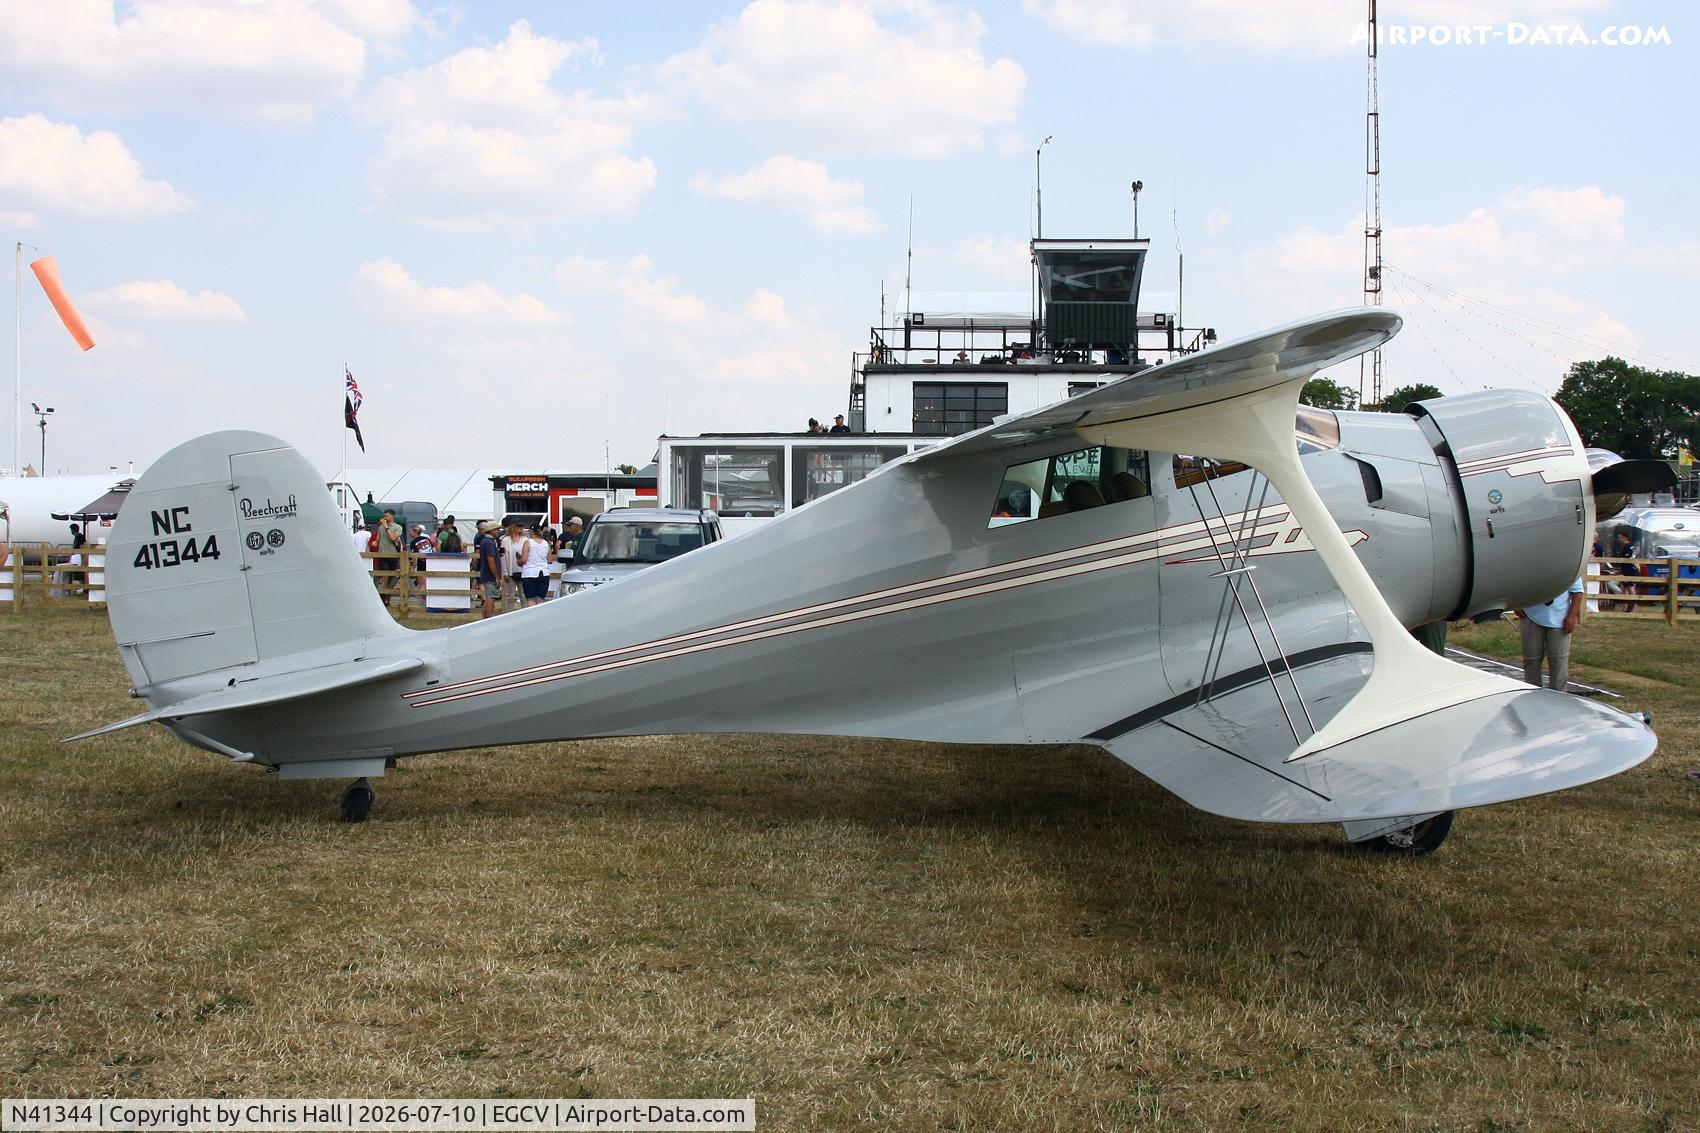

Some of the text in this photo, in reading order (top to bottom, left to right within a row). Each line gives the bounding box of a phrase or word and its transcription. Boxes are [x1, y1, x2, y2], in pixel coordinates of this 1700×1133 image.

[506, 482, 549, 491] MERCH
[240, 494, 297, 518] Beechcraft
[151, 506, 192, 536] NC
[133, 535, 221, 569] 41344
